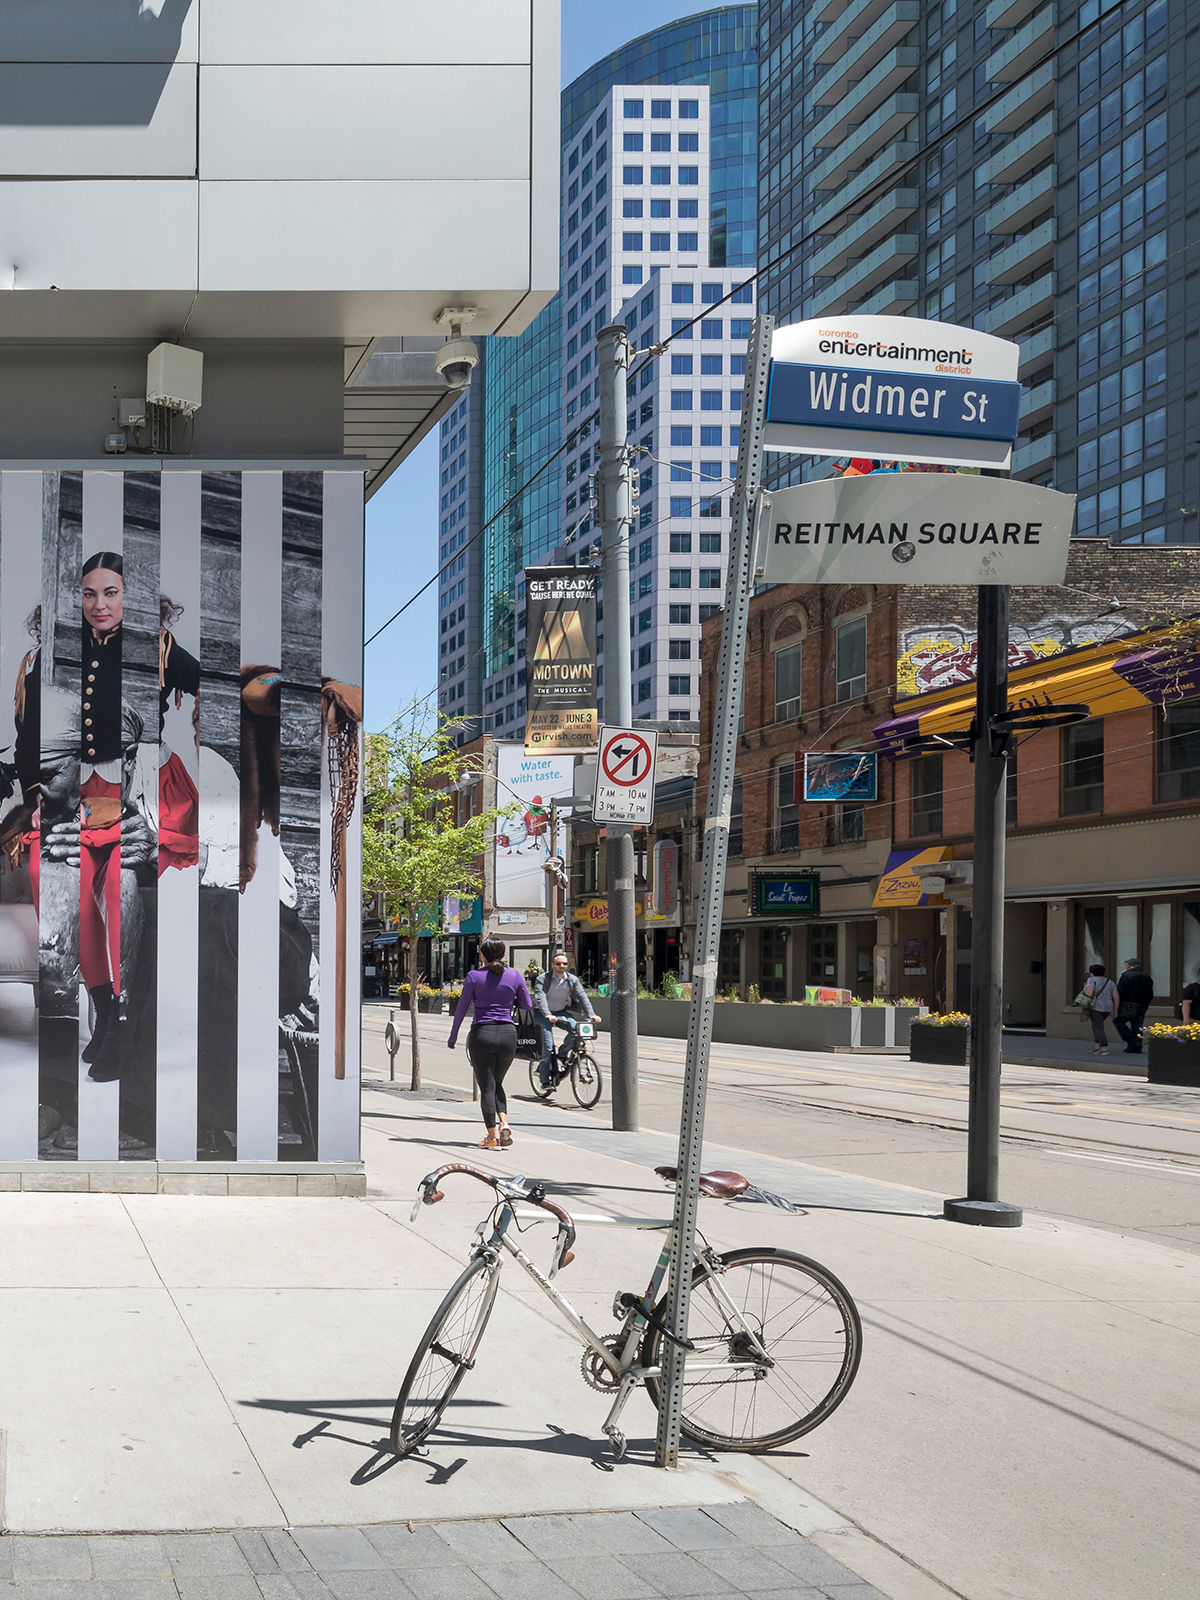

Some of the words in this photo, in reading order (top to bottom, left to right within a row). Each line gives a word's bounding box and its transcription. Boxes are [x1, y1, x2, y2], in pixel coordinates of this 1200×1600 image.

[818, 328, 859, 339] toronto
[818, 339, 973, 365] entertainment
[935, 363, 972, 375] district
[809, 370, 946, 419] Widmer
[961, 390, 989, 423] St
[774, 522, 908, 545] REITMAN
[917, 522, 1043, 545] SQUARE
[530, 580, 553, 591] GET
[556, 579, 595, 590] READY,
[552, 590, 567, 599] HERE
[567, 591, 575, 599] WE
[531, 714, 548, 724] MAY
[549, 713, 559, 723] 22
[566, 713, 585, 723] JUNE
[586, 713, 593, 723] 3
[521, 760, 552, 771] Water
[511, 772, 533, 784] with
[535, 770, 563, 782] taste.
[599, 787, 605, 797] 7
[628, 789, 637, 799] 10
[599, 801, 605, 811] 3
[606, 803, 615, 811] PM
[629, 803, 634, 812] 7
[662, 851, 673, 911] BUFFET
[783, 882, 792, 892] Le
[885, 879, 919, 893] ZAZOU
[767, 891, 785, 902] Saint
[788, 891, 809, 904] Tropez
